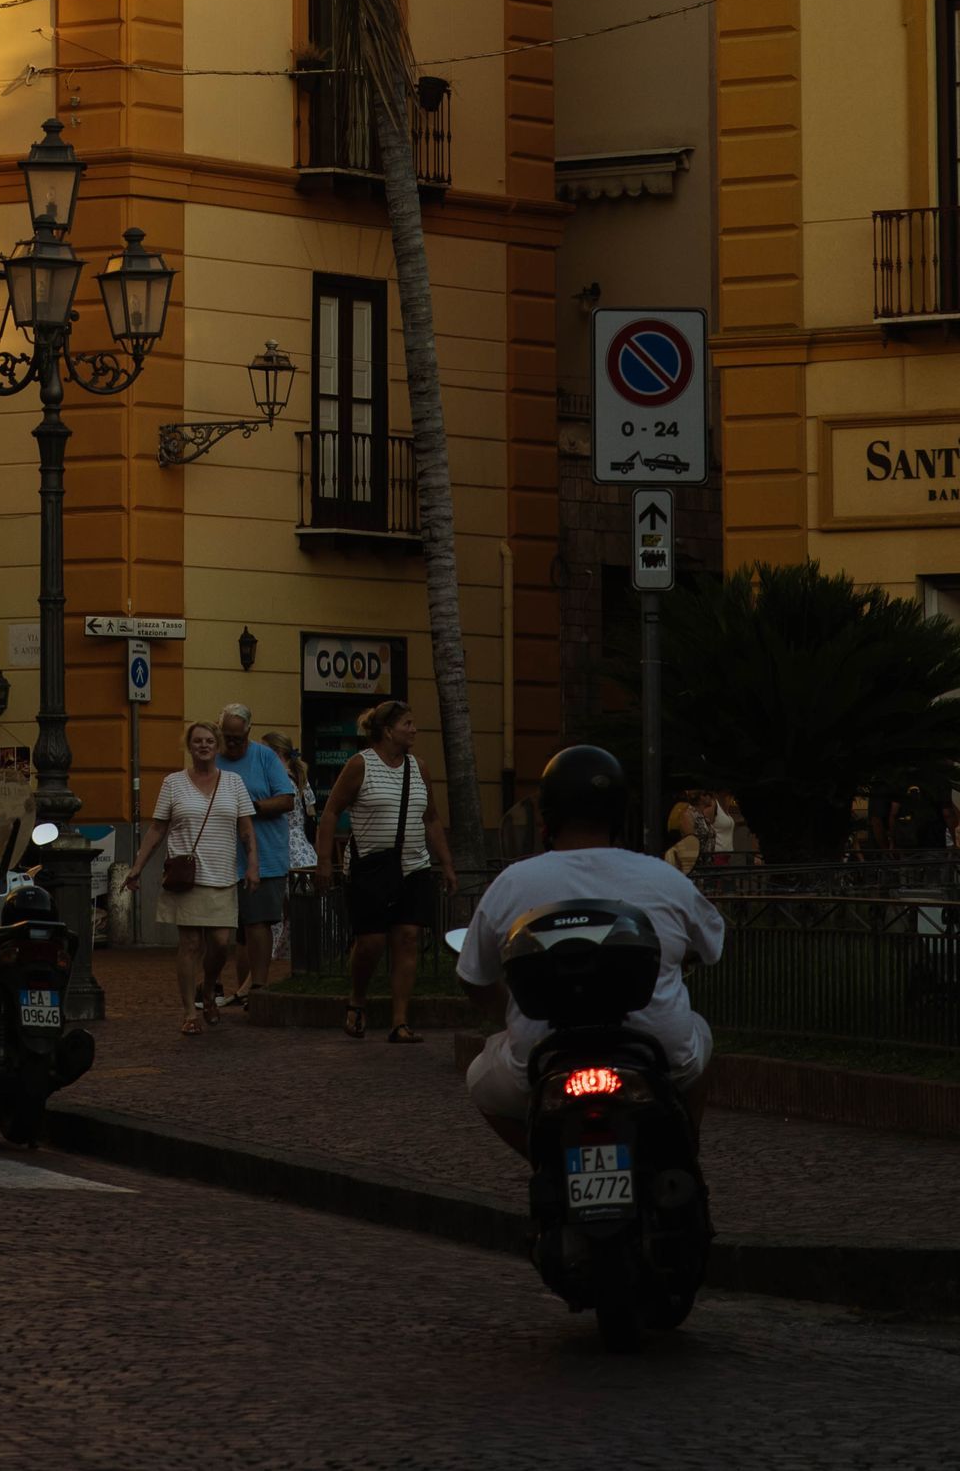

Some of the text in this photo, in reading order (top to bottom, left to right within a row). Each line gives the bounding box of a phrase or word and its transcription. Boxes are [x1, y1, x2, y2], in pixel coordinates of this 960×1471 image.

[621, 420, 635, 437] 0
[654, 421, 680, 437] 24
[137, 621, 183, 629] piazza Tasso
[554, 916, 590, 926] SHAD
[30, 991, 44, 1005] EA
[23, 1008, 59, 1024] 09646
[581, 1147, 606, 1171] FA
[570, 1175, 631, 1203] 64772
